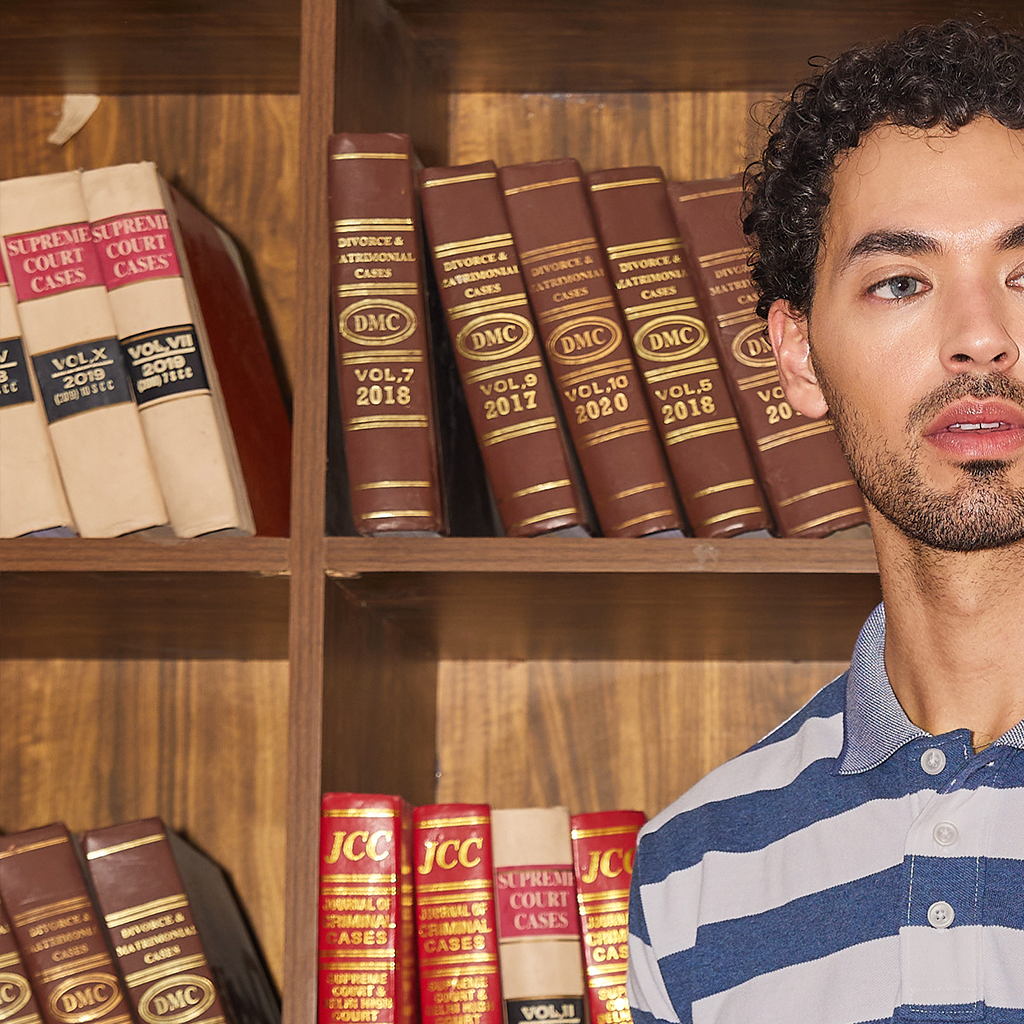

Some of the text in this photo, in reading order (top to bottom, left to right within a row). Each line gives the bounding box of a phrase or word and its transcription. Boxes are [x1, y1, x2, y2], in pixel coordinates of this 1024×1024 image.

[7, 227, 92, 256] SUPREME
[106, 234, 167, 259] COURT
[337, 236, 404, 248] DIVORCE &
[23, 247, 84, 274] COURT
[113, 254, 170, 278] CASES
[337, 252, 416, 264] ATRIMONIAL
[443, 251, 508, 272] DIVORCE &
[530, 256, 594, 277] DIVORCE &
[618, 254, 681, 273] DIVORCE &
[31, 267, 87, 293] CASES
[354, 268, 393, 279] CASES
[464, 283, 502, 299] CASES
[552, 287, 589, 303] CASES
[640, 285, 678, 300] CASES
[354, 313, 401, 333] DMC
[471, 324, 518, 350] DMC
[560, 328, 607, 354] DMC
[650, 327, 695, 351] DMC
[746, 337, 772, 356] DM
[142, 355, 186, 377] 2019
[63, 368, 106, 389] 2019
[356, 385, 411, 406] 2018
[757, 386, 785, 402] VO
[484, 390, 538, 420] 2017
[575, 393, 629, 424] 2020
[662, 396, 715, 425] 2018
[766, 402, 792, 424] 20
[324, 830, 393, 865] JCC
[417, 837, 484, 875] JCC
[322, 898, 376, 911] JOURNAL
[510, 891, 569, 910] COURT
[419, 902, 488, 920] JOURNAL OF
[514, 912, 569, 930] CASES
[121, 912, 185, 939] DIVORCE &
[322, 914, 396, 929] CRIMINAL
[418, 918, 492, 938] CRIMINAL
[326, 930, 388, 945] CASES
[424, 935, 486, 953] CASES
[52, 943, 89, 962] CASES
[143, 944, 181, 964] CASES
[326, 972, 388, 985] SUPREME
[427, 976, 488, 992] SUPREME
[62, 984, 109, 1013] DMC
[153, 986, 199, 1016] DMC
[331, 985, 386, 997] COURT &
[434, 989, 488, 1003] COURT &
[331, 1009, 380, 1022] COURT
